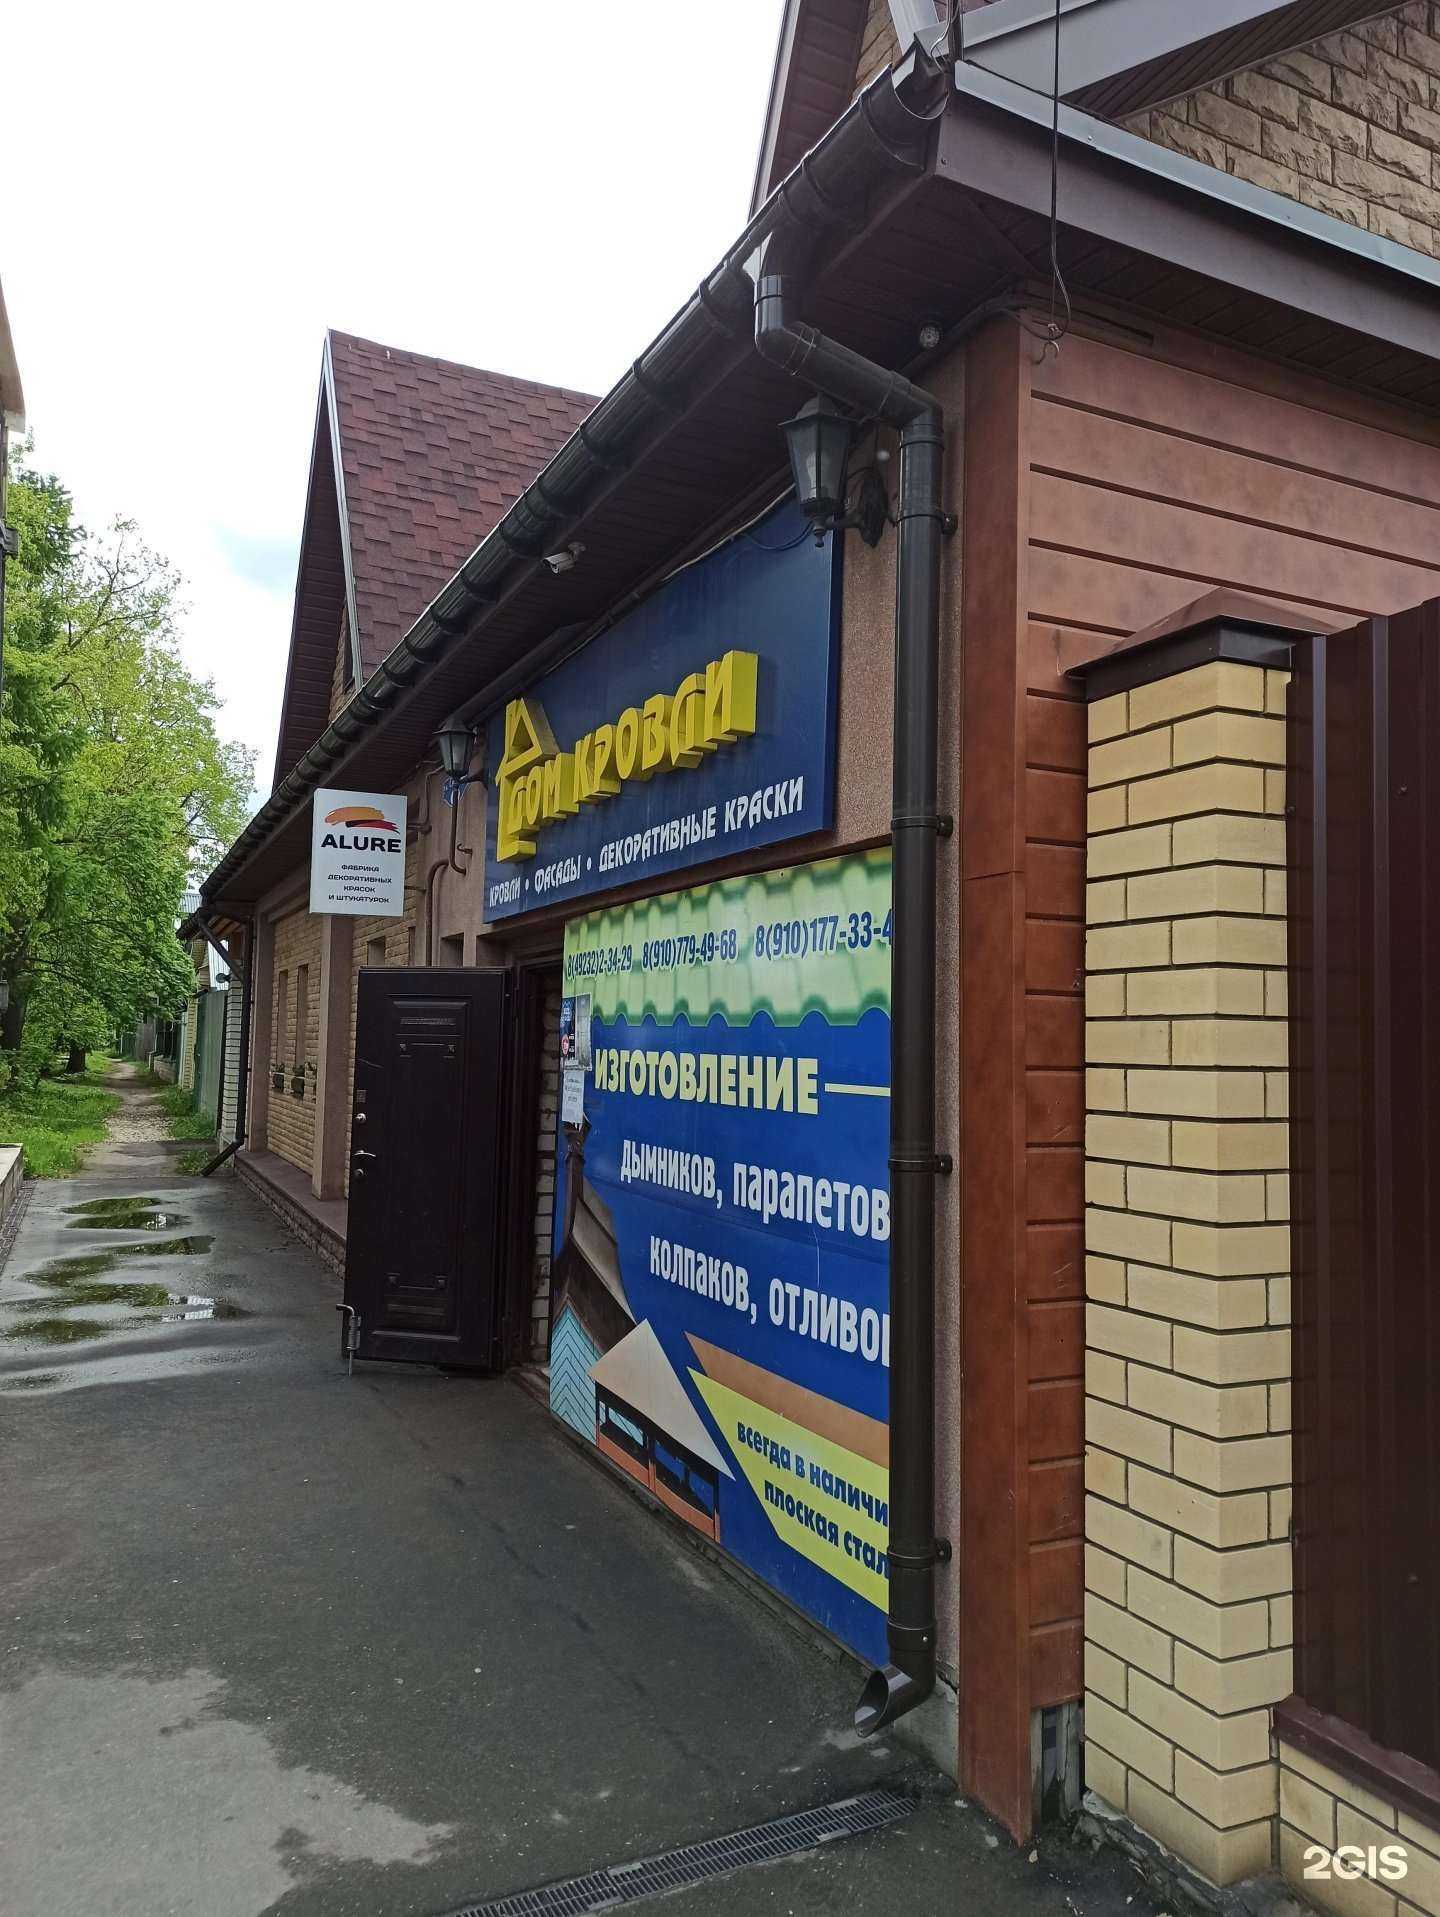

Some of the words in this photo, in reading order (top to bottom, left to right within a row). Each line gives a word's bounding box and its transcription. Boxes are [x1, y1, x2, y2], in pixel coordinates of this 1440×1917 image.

[573, 650, 759, 805] КРОВЛИ
[320, 833, 402, 853] ALURE
[489, 885, 520, 908] КРОВЛИ
[534, 854, 581, 894] ФАСАДЫ
[598, 806, 716, 873] ДЕКОРАТИВНЫЕ
[724, 775, 805, 833] КРАСКИ
[327, 875, 392, 884] ДЕКОРАТИВНЫХ
[340, 864, 380, 872] ФАБРИКА
[343, 885, 376, 893] КРАСОК
[336, 895, 391, 904] ШТУКАТУРОК
[567, 944, 633, 979] 8(49232)2-34-29
[642, 929, 737, 971] 8(910)779-49-68
[595, 1048, 819, 1116] ИЗГОТОВЛЕНИЕ
[737, 1421, 791, 1471] всегда
[795, 1454, 805, 1479] в
[764, 1480, 839, 1547] плоская
